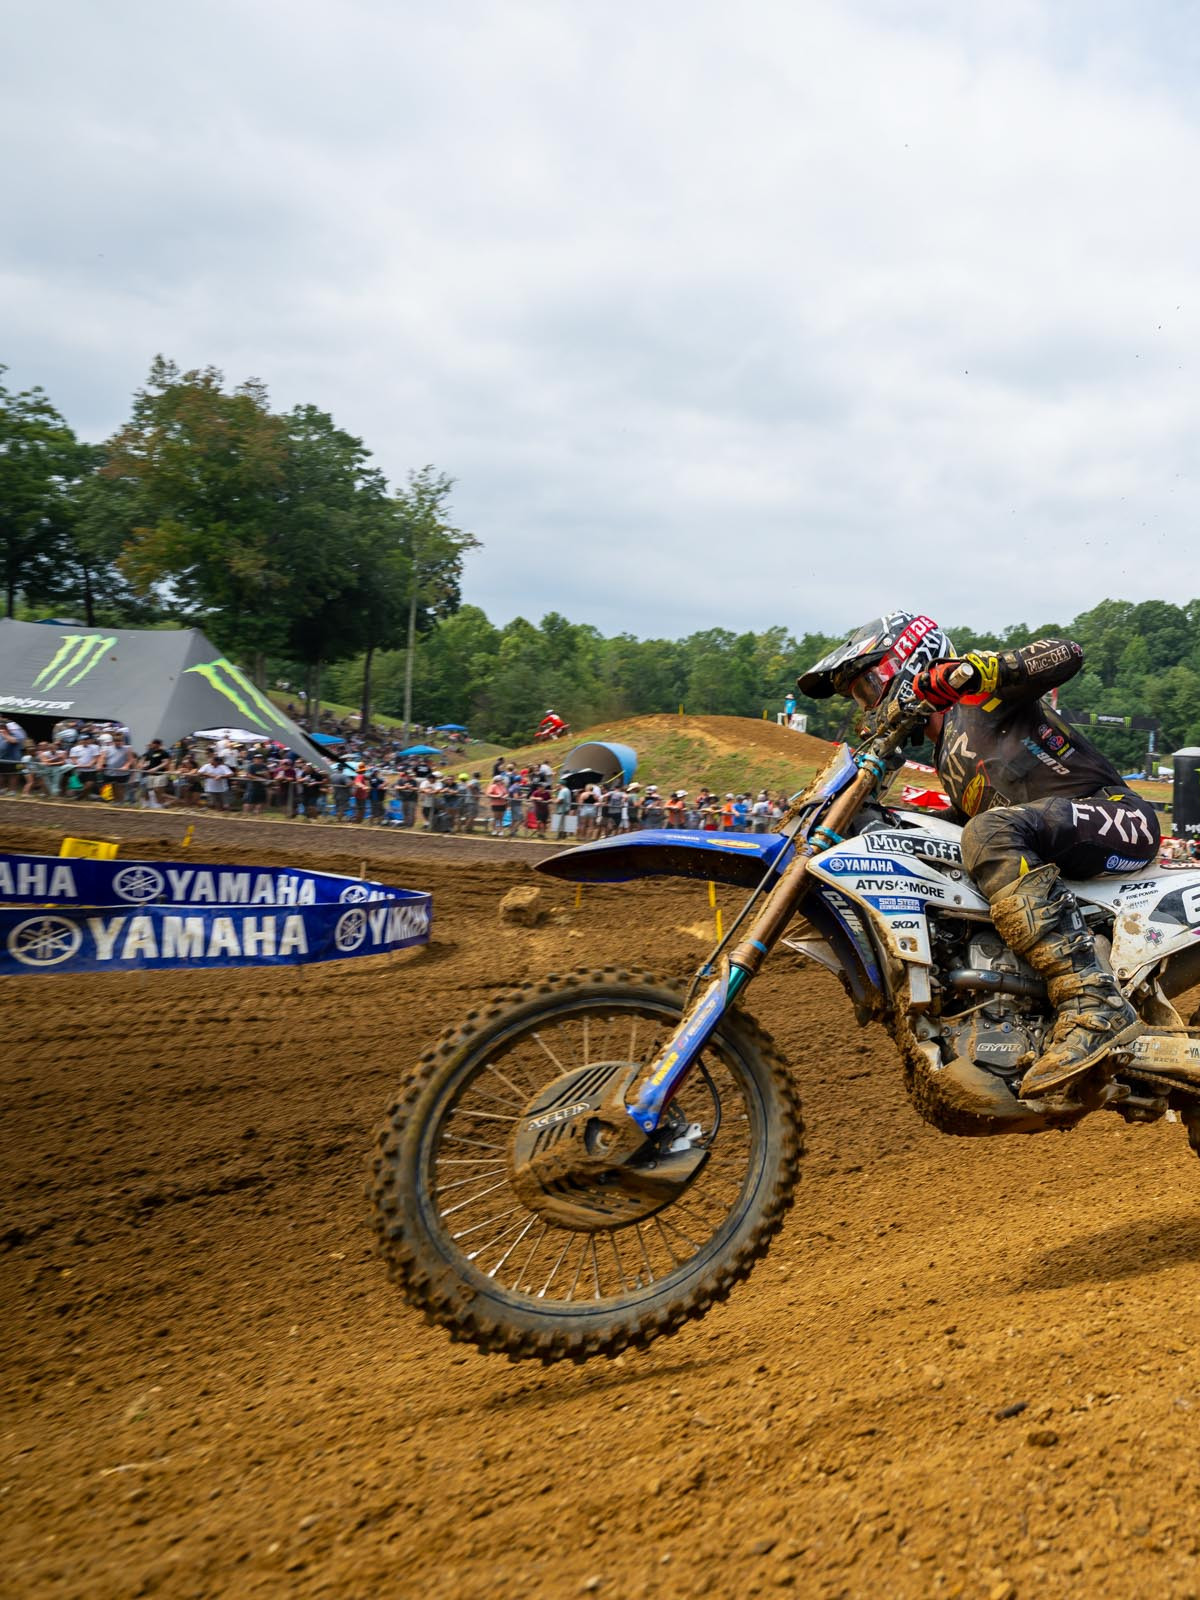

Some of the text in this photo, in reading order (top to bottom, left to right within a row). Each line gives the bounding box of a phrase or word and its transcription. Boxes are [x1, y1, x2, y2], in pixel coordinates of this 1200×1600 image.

[1027, 646, 1068, 673] Muc-Off
[1071, 802, 1154, 845] FXR
[873, 834, 959, 862] Muc-Off
[845, 859, 894, 873] YAMAHA
[166, 869, 316, 905] YAMAHA
[1119, 881, 1157, 894] FXR
[86, 914, 309, 961] YAMAHA
